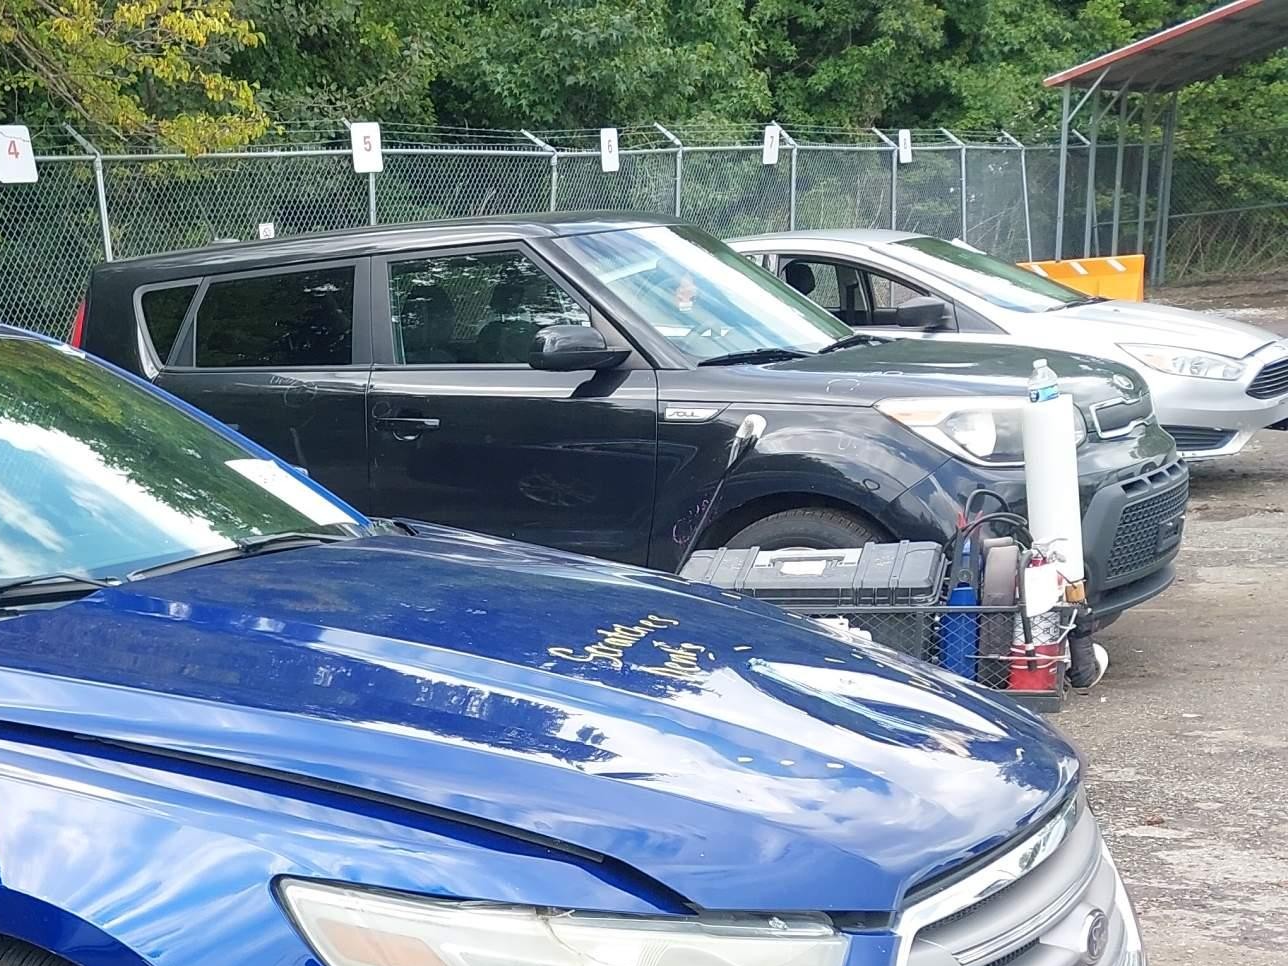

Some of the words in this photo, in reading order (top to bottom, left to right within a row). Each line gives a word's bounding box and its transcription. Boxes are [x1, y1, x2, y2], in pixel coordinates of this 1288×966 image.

[8, 140, 20, 159] 4
[363, 135, 372, 152] 5
[608, 139, 613, 154] 6
[770, 136, 775, 149] 7
